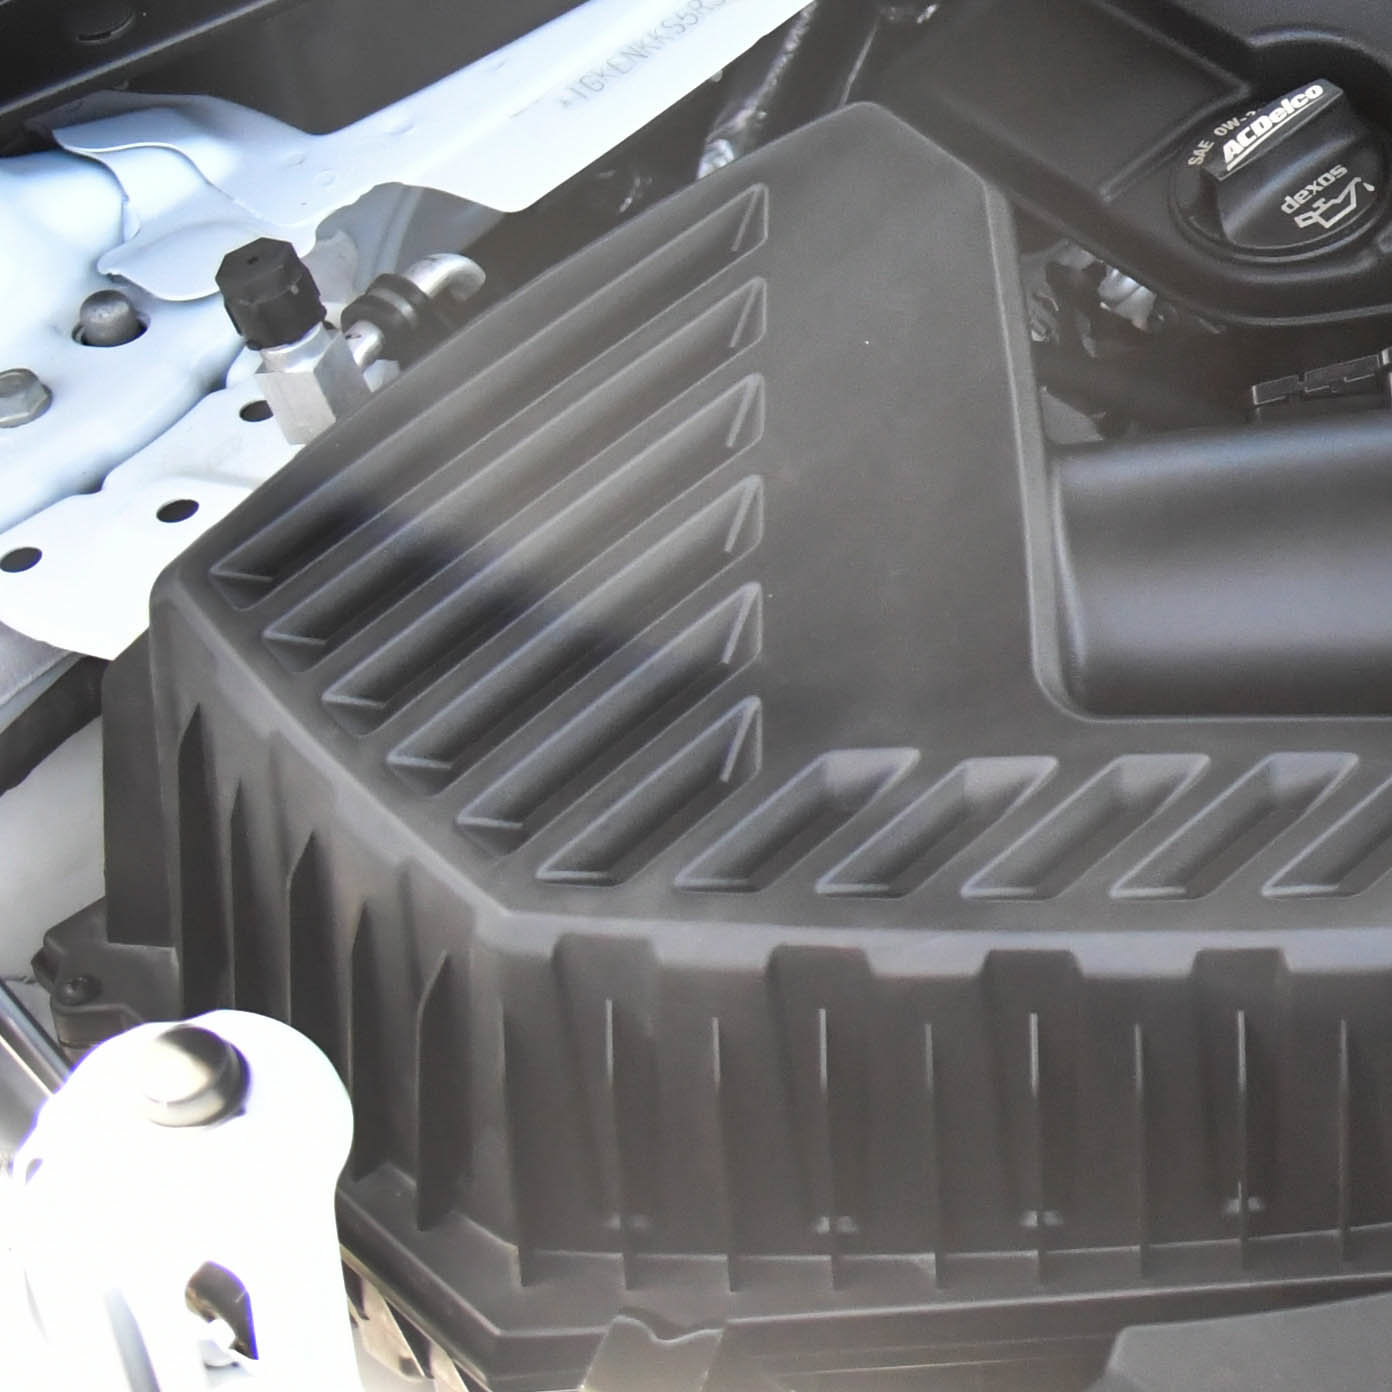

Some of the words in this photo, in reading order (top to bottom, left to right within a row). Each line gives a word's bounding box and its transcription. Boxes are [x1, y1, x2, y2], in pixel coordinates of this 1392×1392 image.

[1223, 85, 1324, 164] ACDelco
[1188, 140, 1214, 166] SAE
[1281, 165, 1348, 214] dexos
